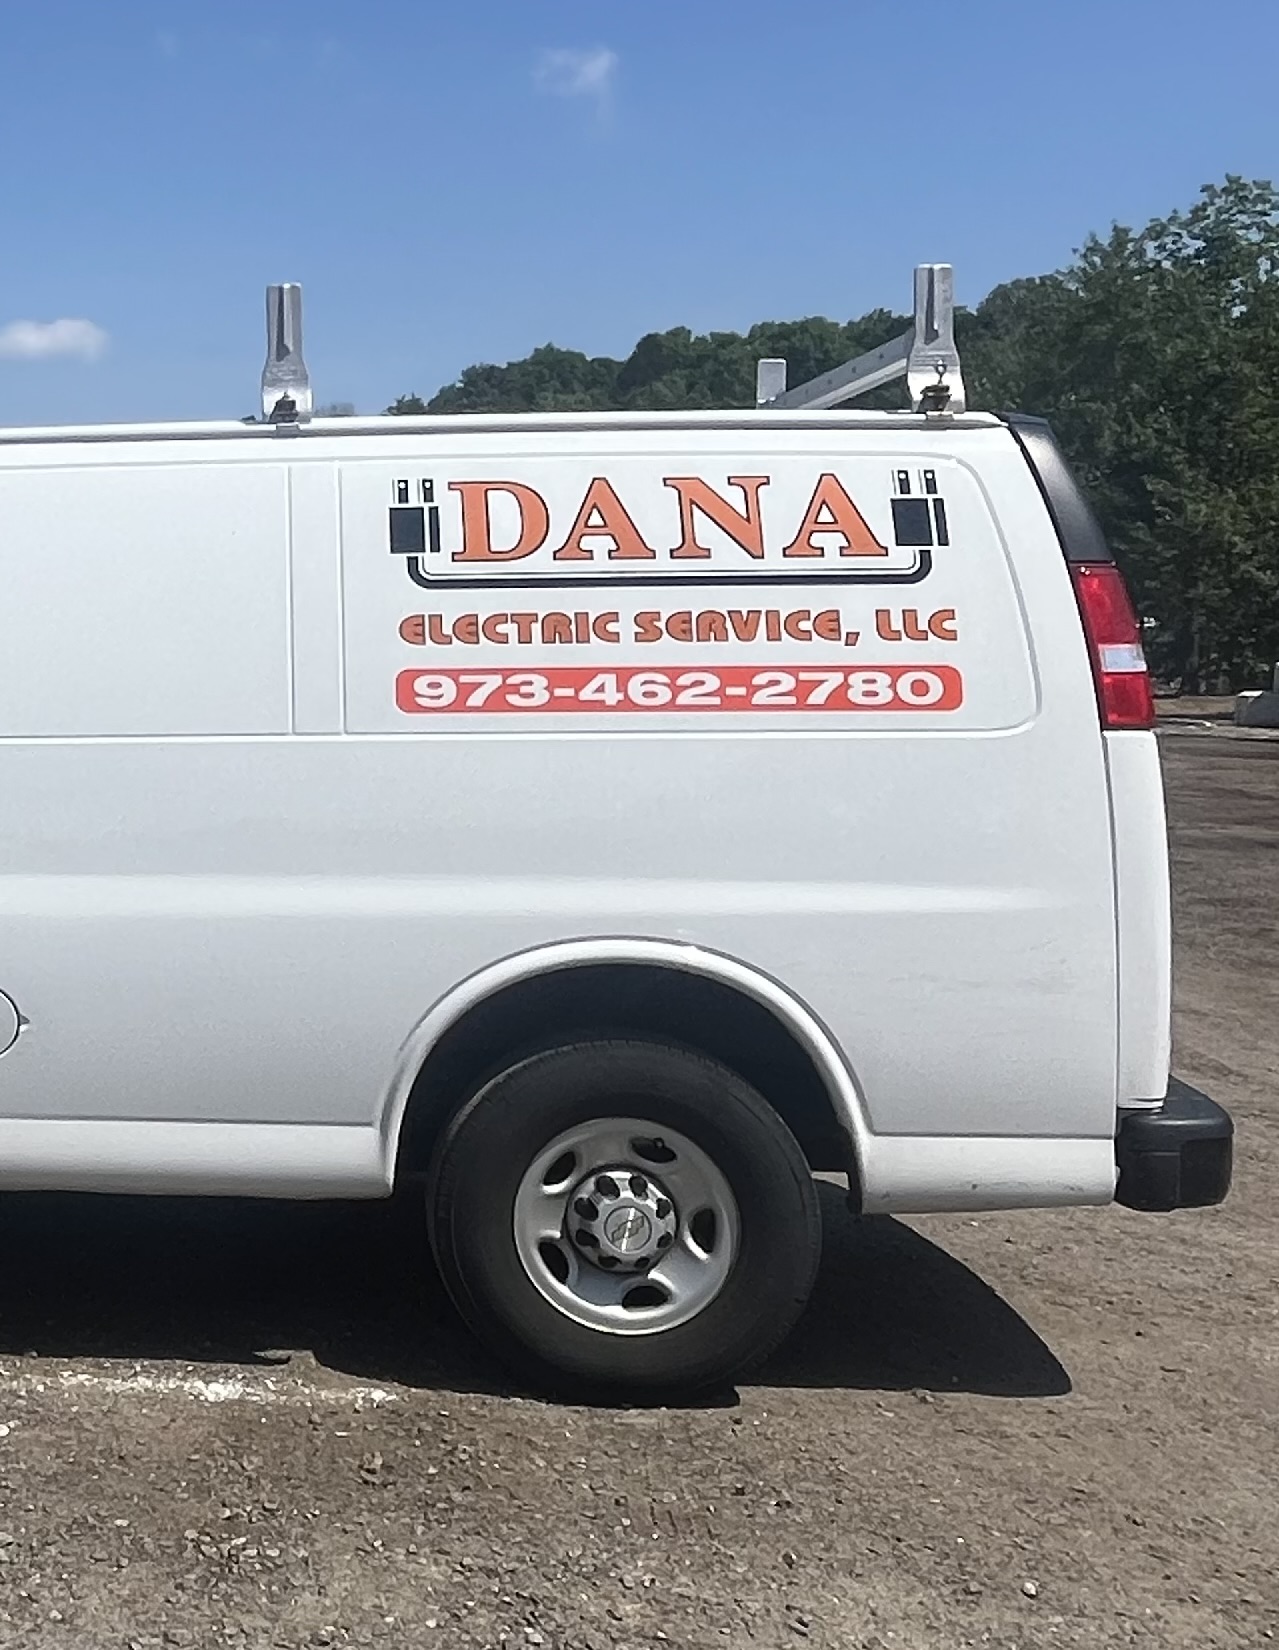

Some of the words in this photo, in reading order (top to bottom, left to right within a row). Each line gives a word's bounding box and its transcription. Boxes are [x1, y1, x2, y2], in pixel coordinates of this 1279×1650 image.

[448, 473, 889, 562] DANA
[399, 611, 620, 645] ELECTRIC
[634, 609, 860, 646] SERVICE,
[875, 608, 959, 641] LLC
[412, 670, 945, 708] 973-462-2780
